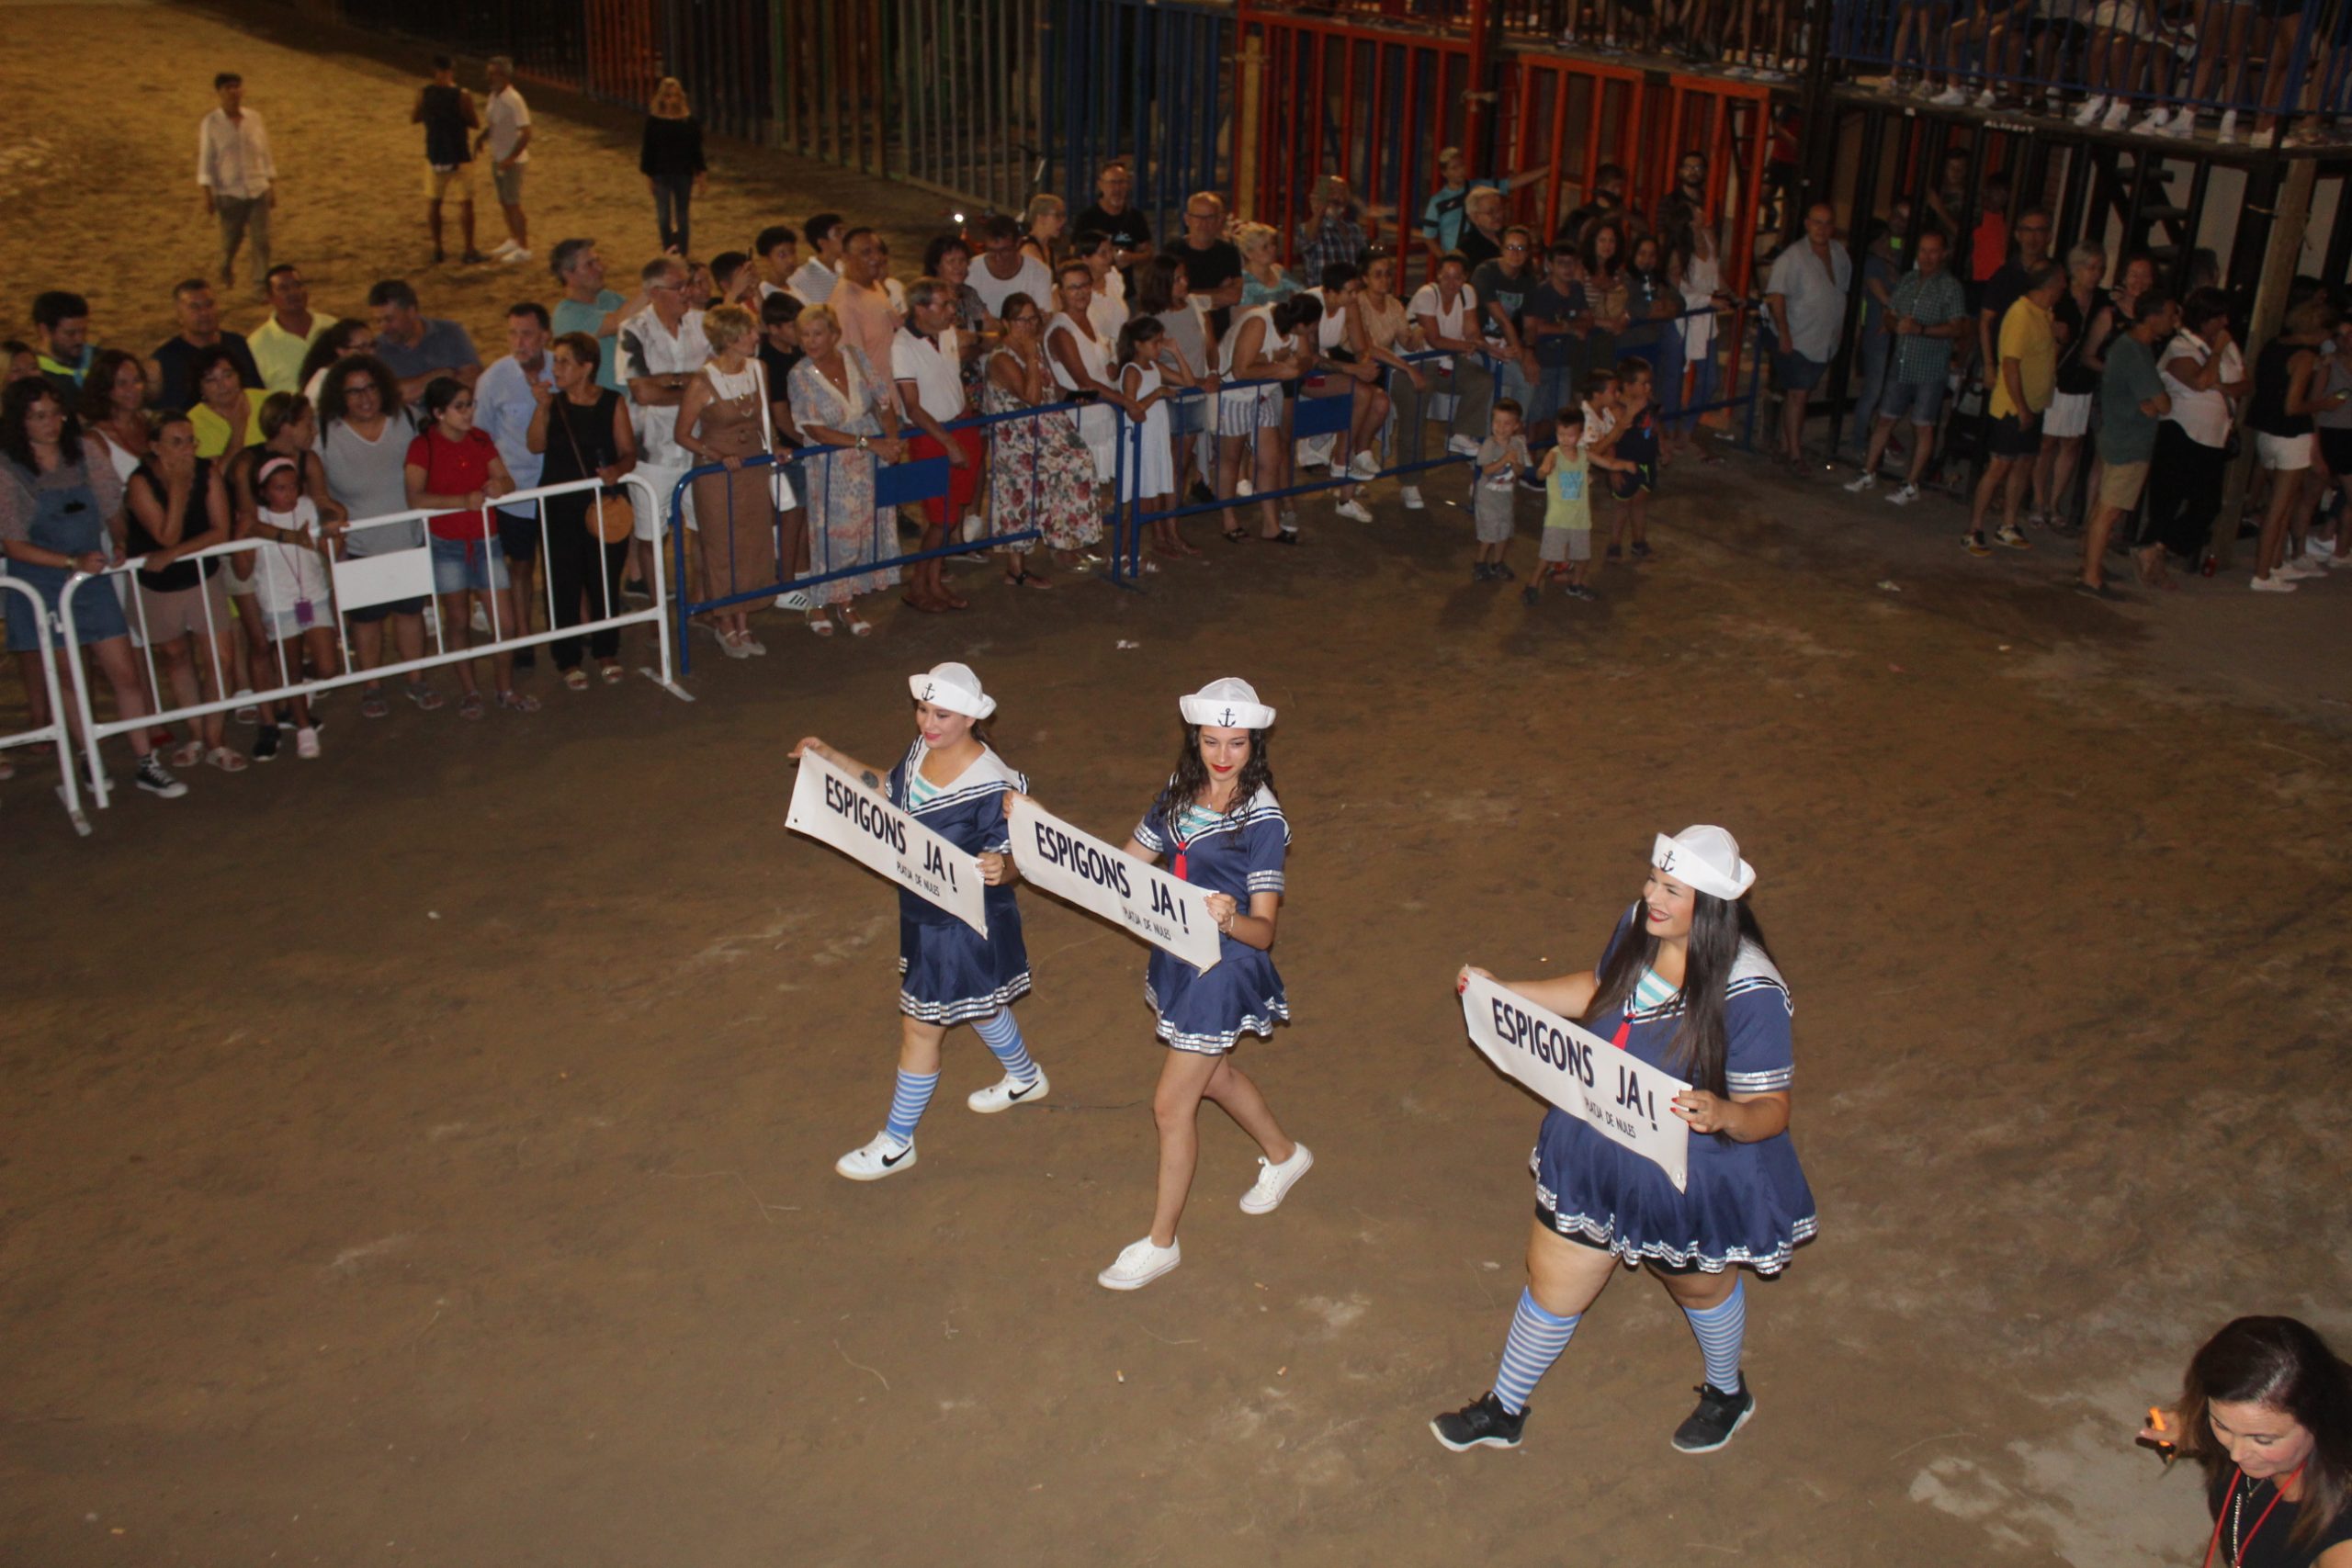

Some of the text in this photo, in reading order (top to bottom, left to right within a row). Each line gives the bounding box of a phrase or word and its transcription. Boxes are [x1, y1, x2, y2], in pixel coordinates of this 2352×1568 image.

[825, 773, 906, 855] ESPIGONS
[914, 873, 922, 886] DE
[923, 879, 940, 897] NULES
[1035, 821, 1131, 898] ESPIGONS
[1143, 918, 1152, 931] DE
[1153, 922, 1171, 941] NULES
[1491, 998, 1594, 1088] ESPIGONS
[1605, 1111, 1614, 1127] DE
[1616, 1116, 1636, 1138] NULES
